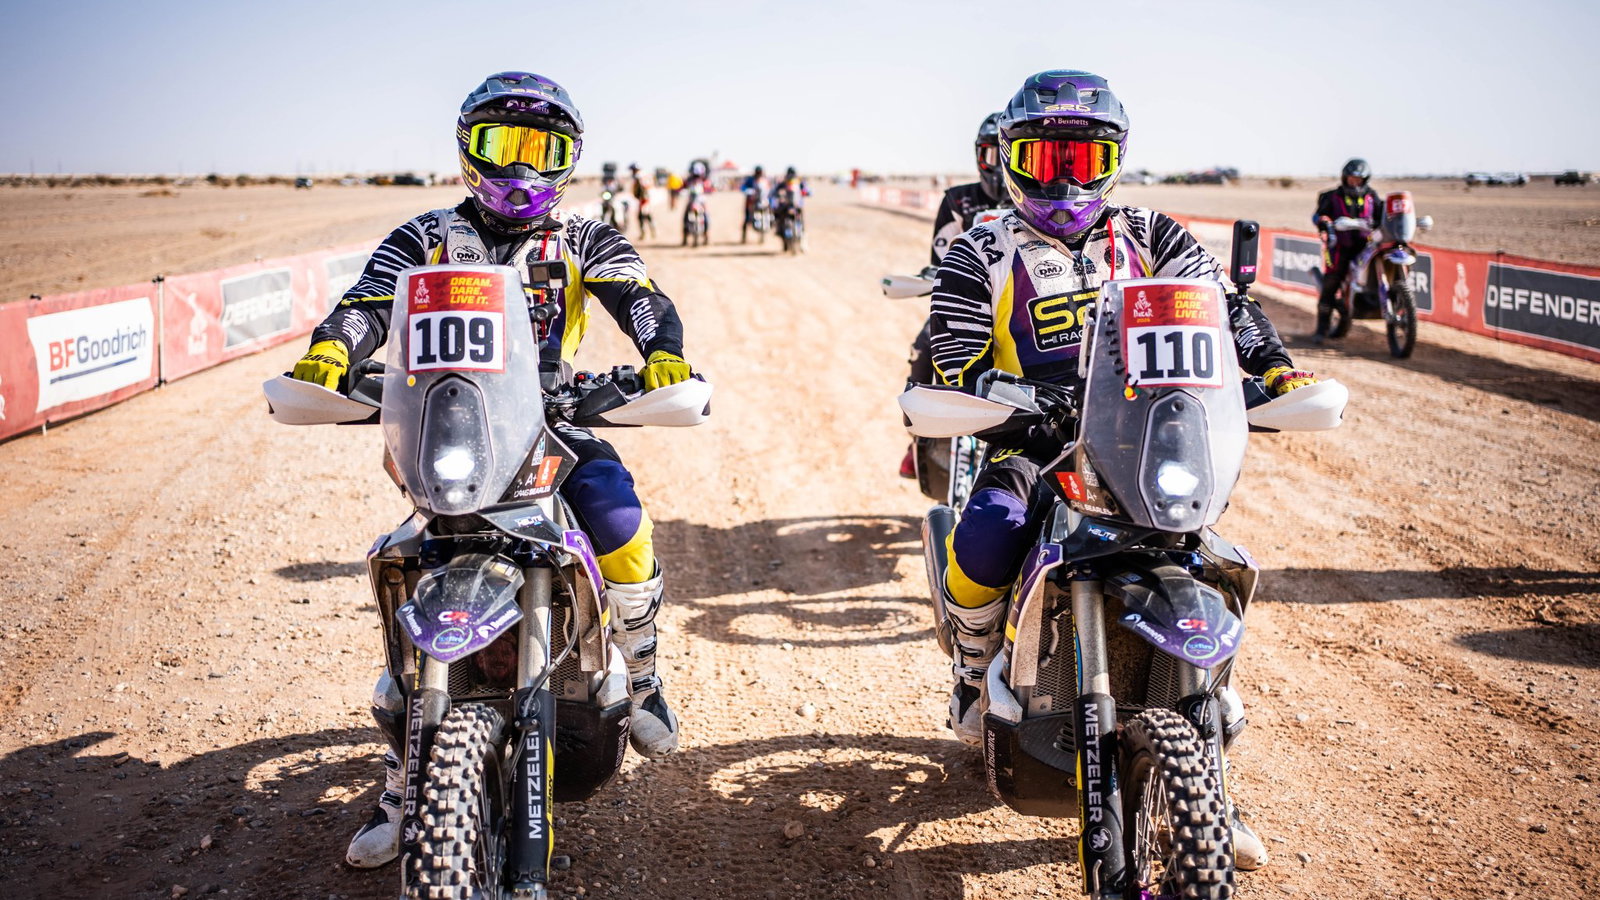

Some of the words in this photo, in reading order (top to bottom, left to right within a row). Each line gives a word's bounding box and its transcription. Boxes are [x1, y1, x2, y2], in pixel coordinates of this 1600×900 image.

[1058, 117, 1089, 127] Bennetts
[450, 277, 493, 287] DREAM.
[450, 287, 483, 295] DARE.
[449, 296, 474, 305] LIVE
[1175, 310, 1197, 318] LIVE
[1486, 284, 1600, 327] DEFENDER
[50, 325, 147, 372] BFGoodrich
[415, 316, 494, 365] 109
[1136, 331, 1215, 380] 110
[1136, 621, 1167, 644] Bennetts
[404, 697, 424, 817] METZELER
[1085, 703, 1103, 823] METZELER
